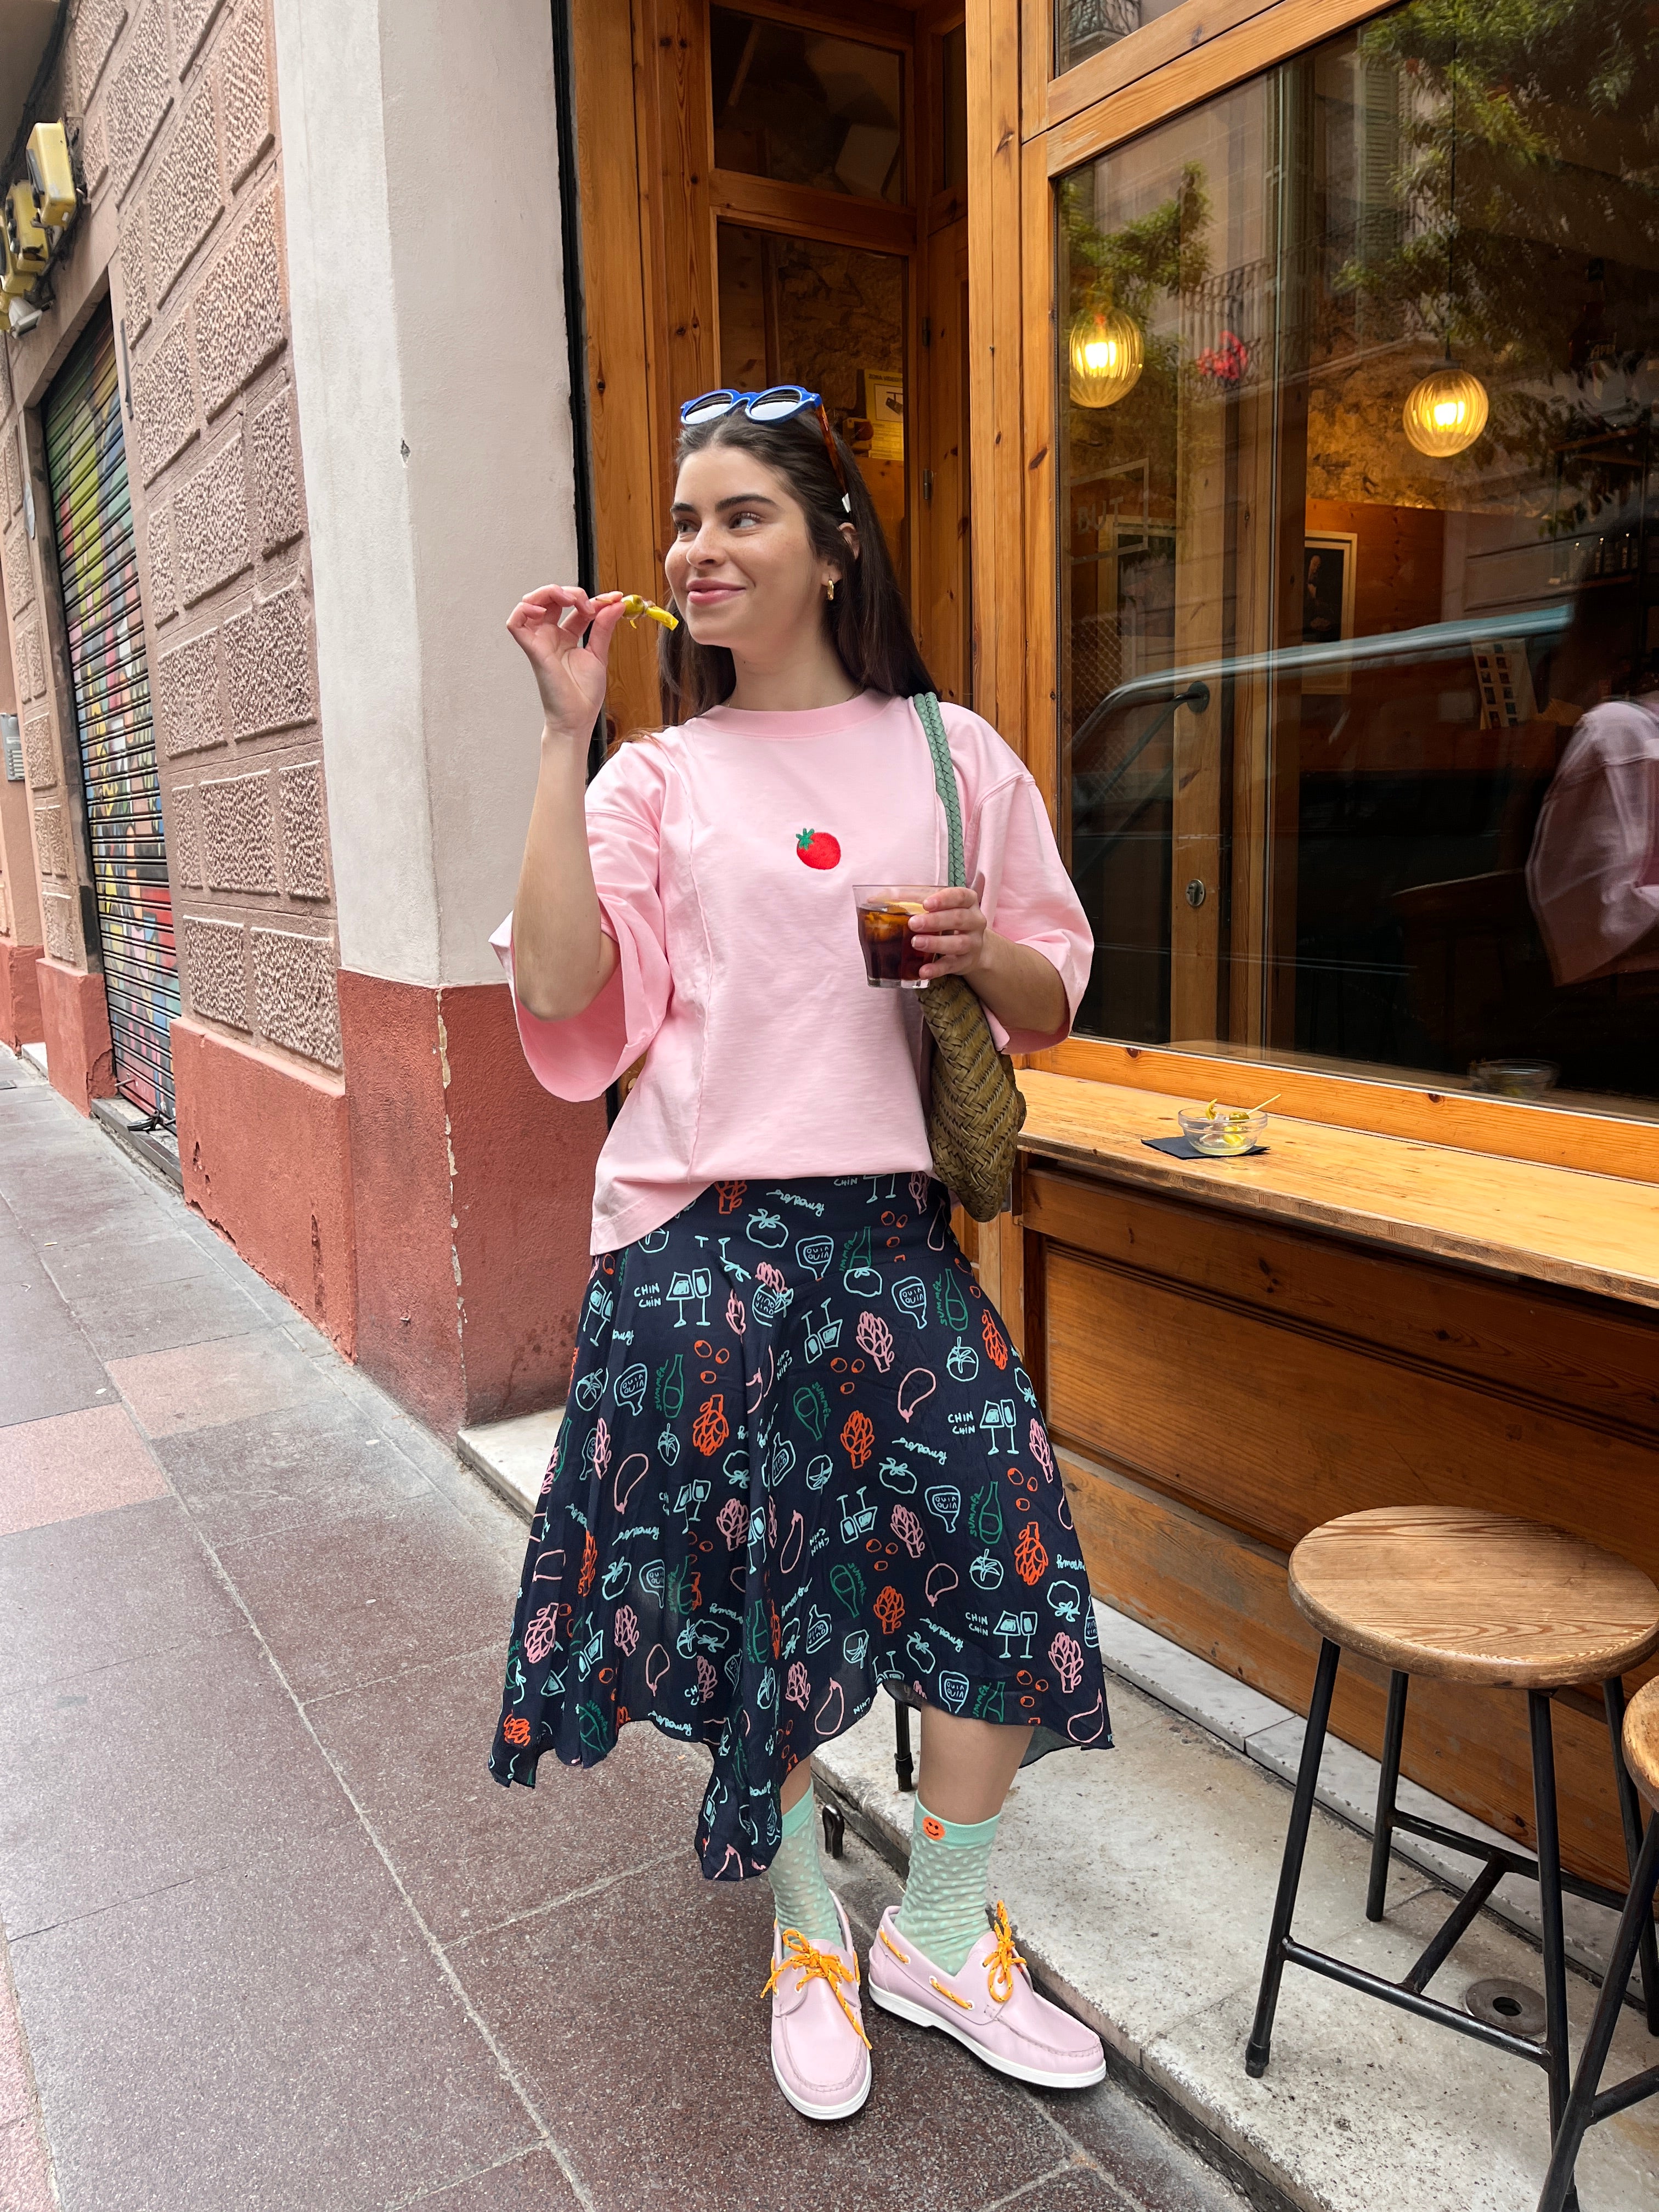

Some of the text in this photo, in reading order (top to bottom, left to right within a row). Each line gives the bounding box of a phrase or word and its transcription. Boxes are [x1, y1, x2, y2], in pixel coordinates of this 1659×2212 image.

[634, 1283, 660, 1297] CHIN
[933, 1273, 947, 1326] SUMMER
[655, 1359, 669, 1411] SUMMER
[947, 1411, 974, 1424] CHIN
[967, 1485, 984, 1537] SUMMER
[965, 1612, 989, 1626] CHIN
